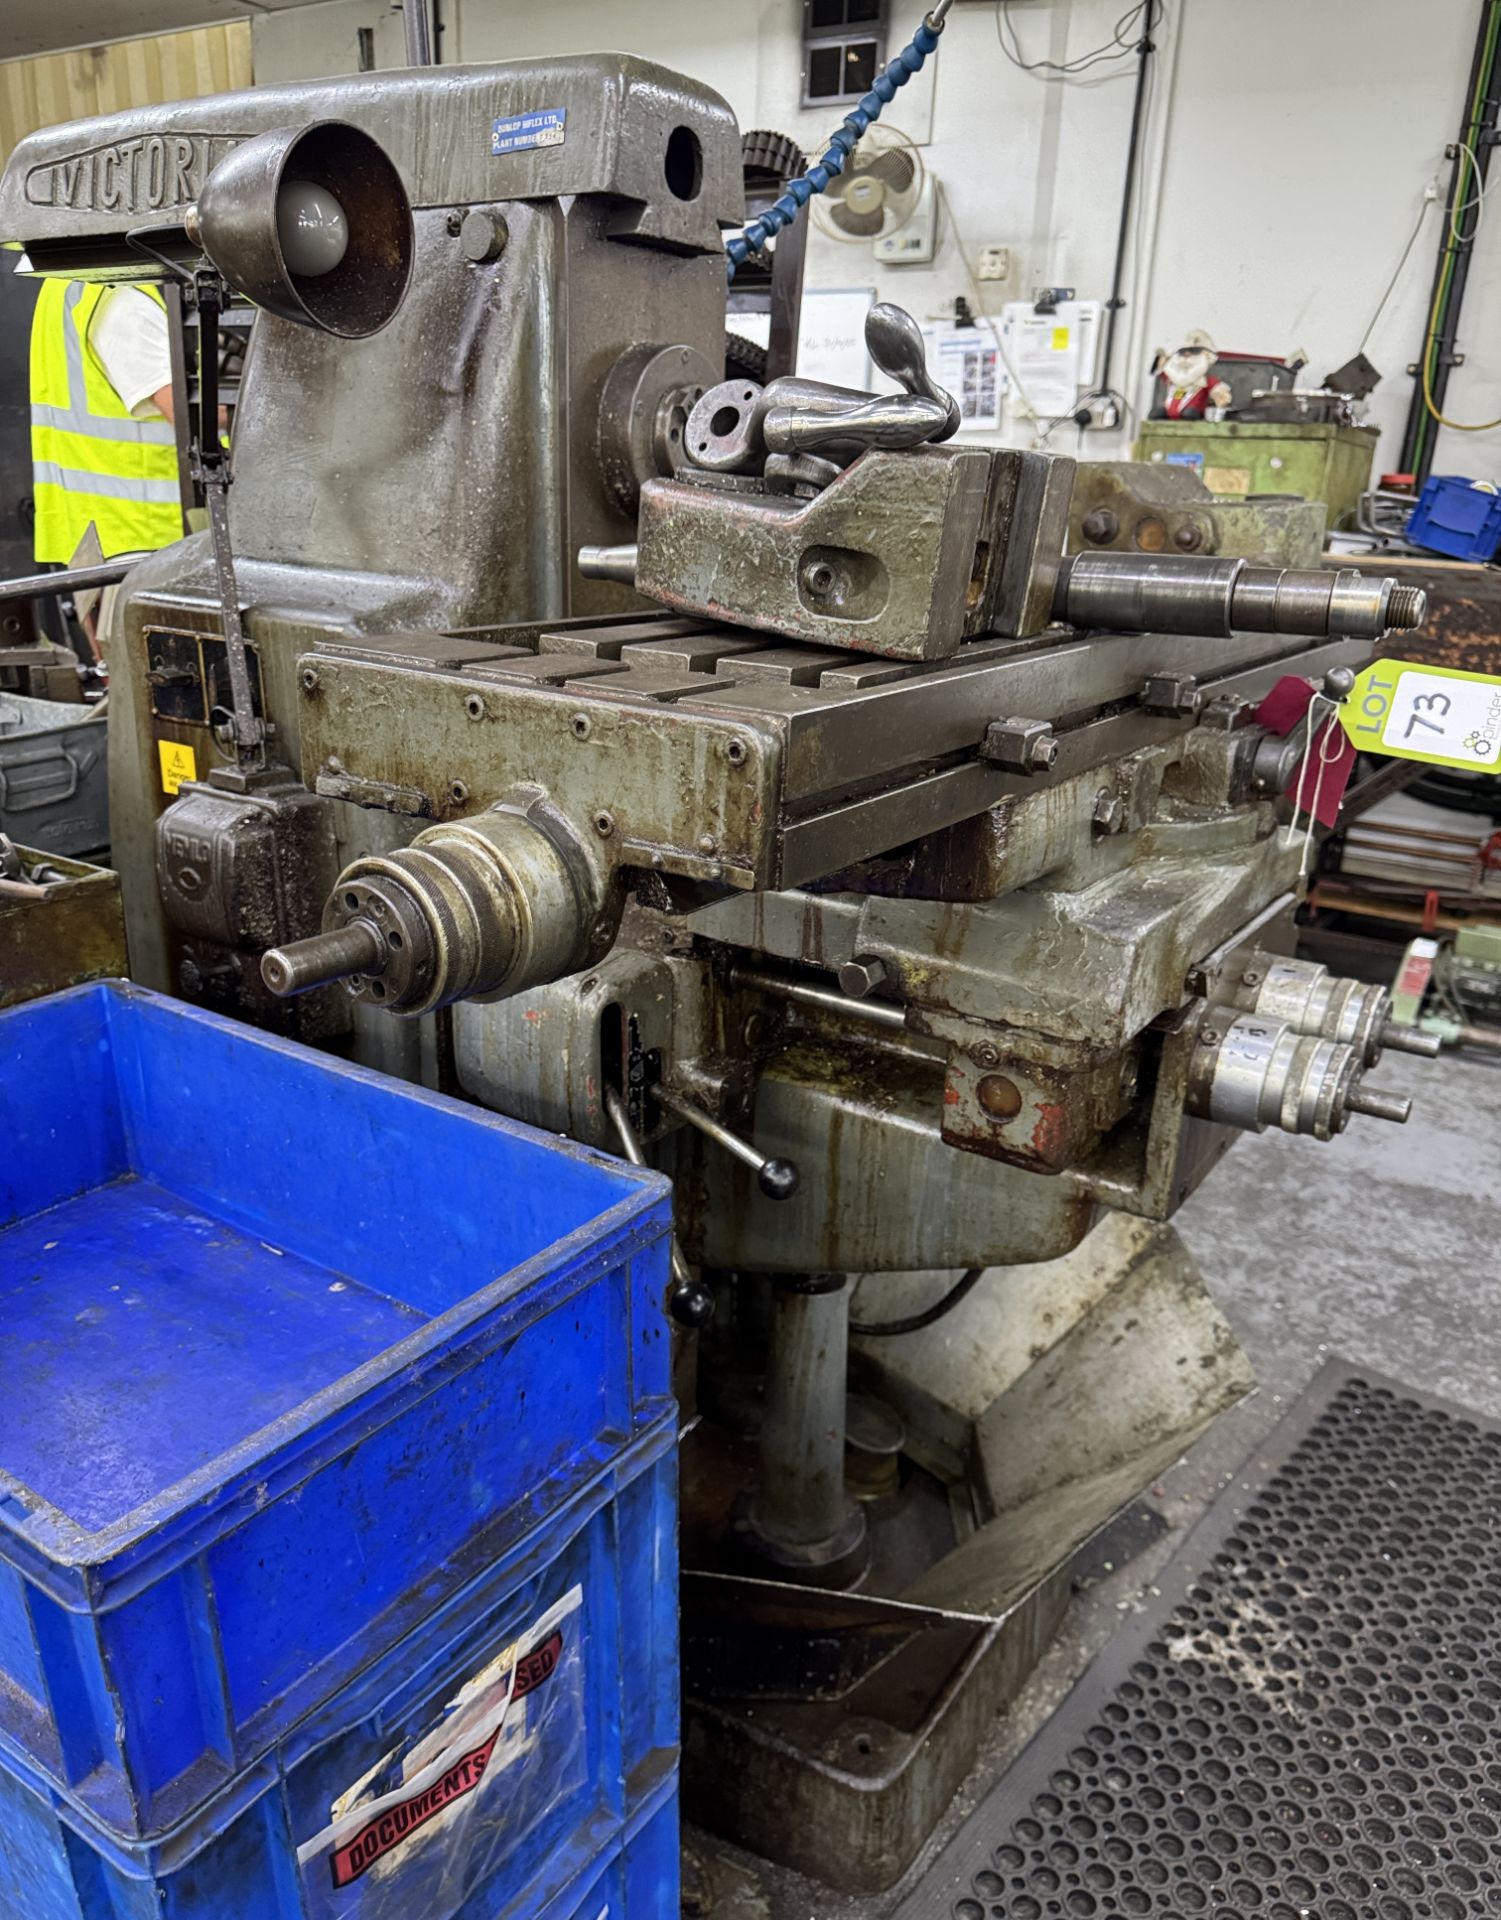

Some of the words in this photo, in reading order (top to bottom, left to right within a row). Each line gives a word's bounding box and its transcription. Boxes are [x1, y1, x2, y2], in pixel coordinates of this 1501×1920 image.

[492, 138, 513, 150] PLANT
[57, 136, 239, 214] VICTORI
[1356, 674, 1393, 734] LOT
[1403, 692, 1452, 739] 73
[1482, 691, 1501, 741] pinder
[348, 1752, 487, 1874] DOCUMENTS
